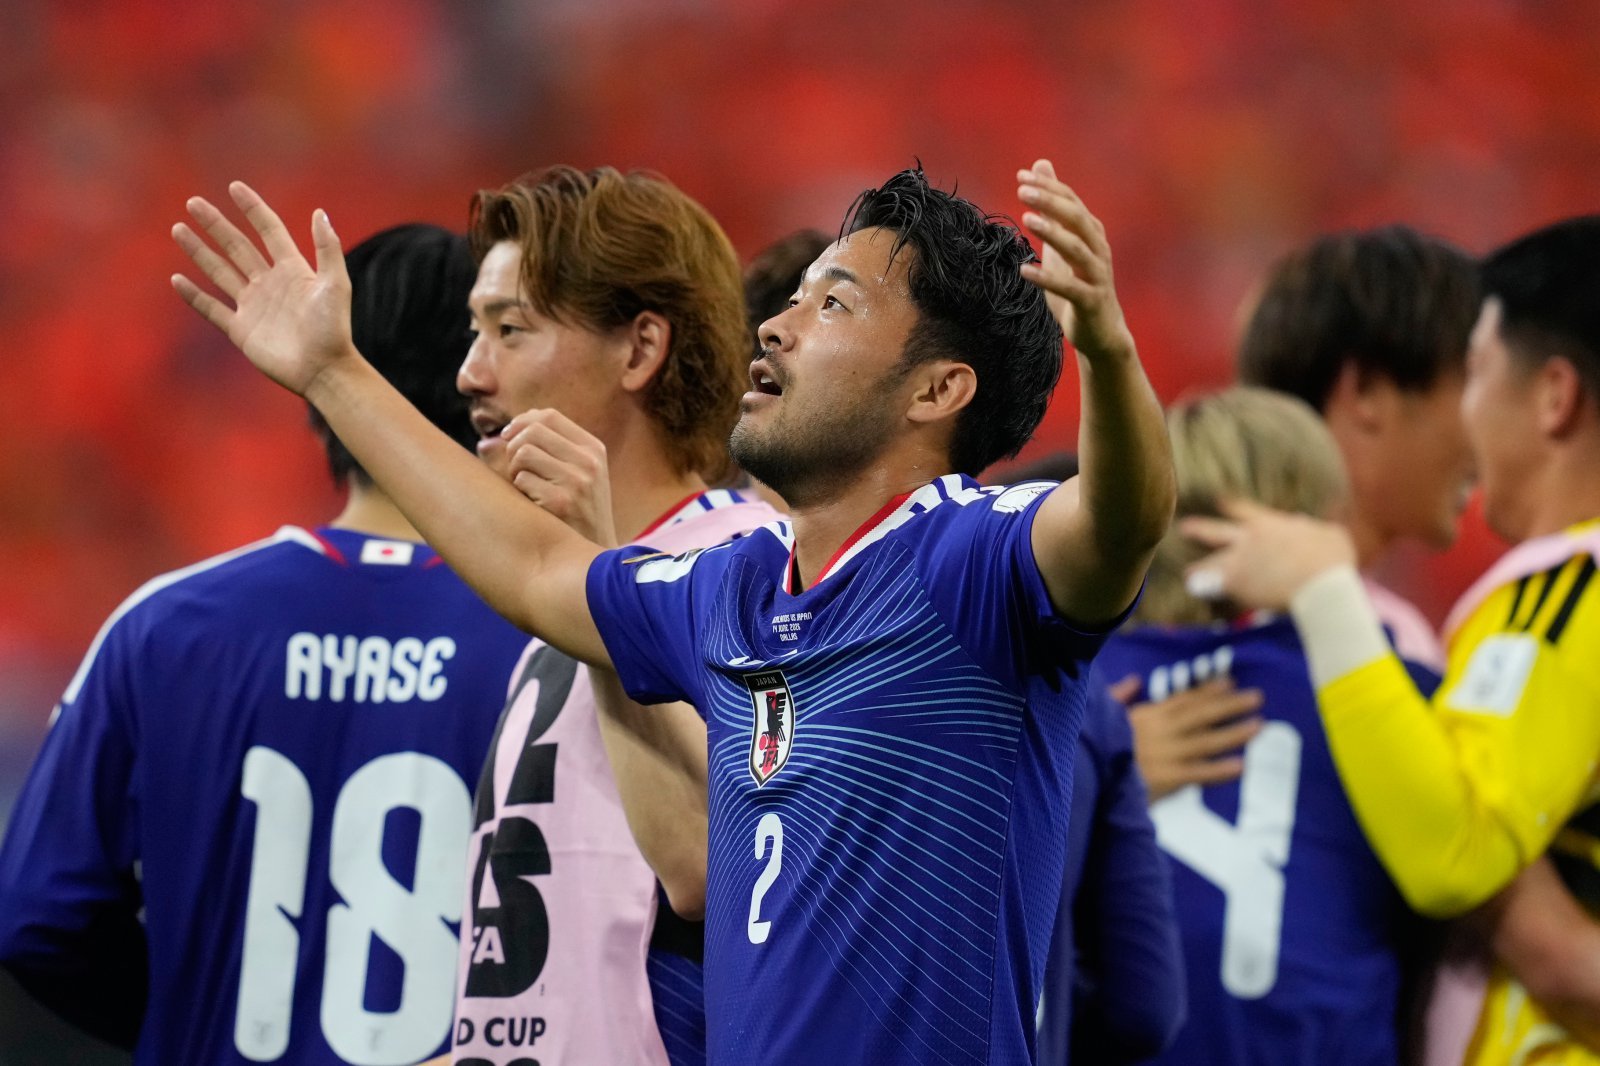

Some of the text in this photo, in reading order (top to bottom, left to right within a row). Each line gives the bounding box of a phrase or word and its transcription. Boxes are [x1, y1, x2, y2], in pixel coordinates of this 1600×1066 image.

[773, 625, 777, 633] 14
[779, 624, 789, 632] JUNE
[780, 633, 798, 641] DALLAS
[284, 631, 456, 704] AYASE
[756, 676, 777, 686] JAPAN
[758, 749, 779, 769] JFA
[747, 813, 784, 945] 2
[234, 745, 474, 1066] 18
[484, 1016, 547, 1047] CUP
